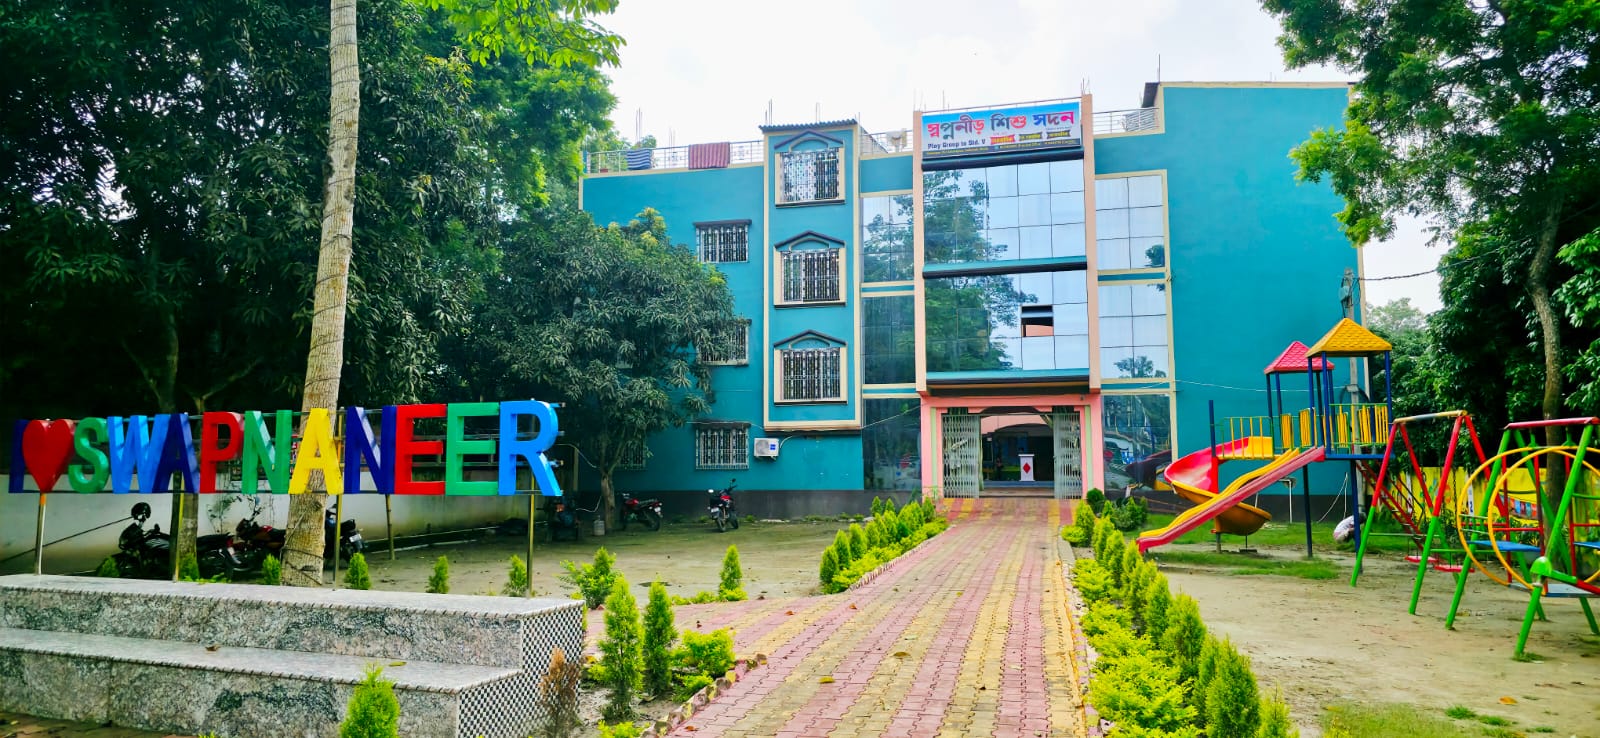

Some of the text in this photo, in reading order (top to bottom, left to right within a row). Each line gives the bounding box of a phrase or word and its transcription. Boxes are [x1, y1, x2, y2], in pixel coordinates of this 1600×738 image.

[927, 114, 985, 140] স্বপ্ননীড়
[990, 113, 1027, 131] শিশু
[1032, 111, 1075, 127] সদন
[942, 141, 960, 149] Group
[68, 400, 562, 497] SWAPNANEER
